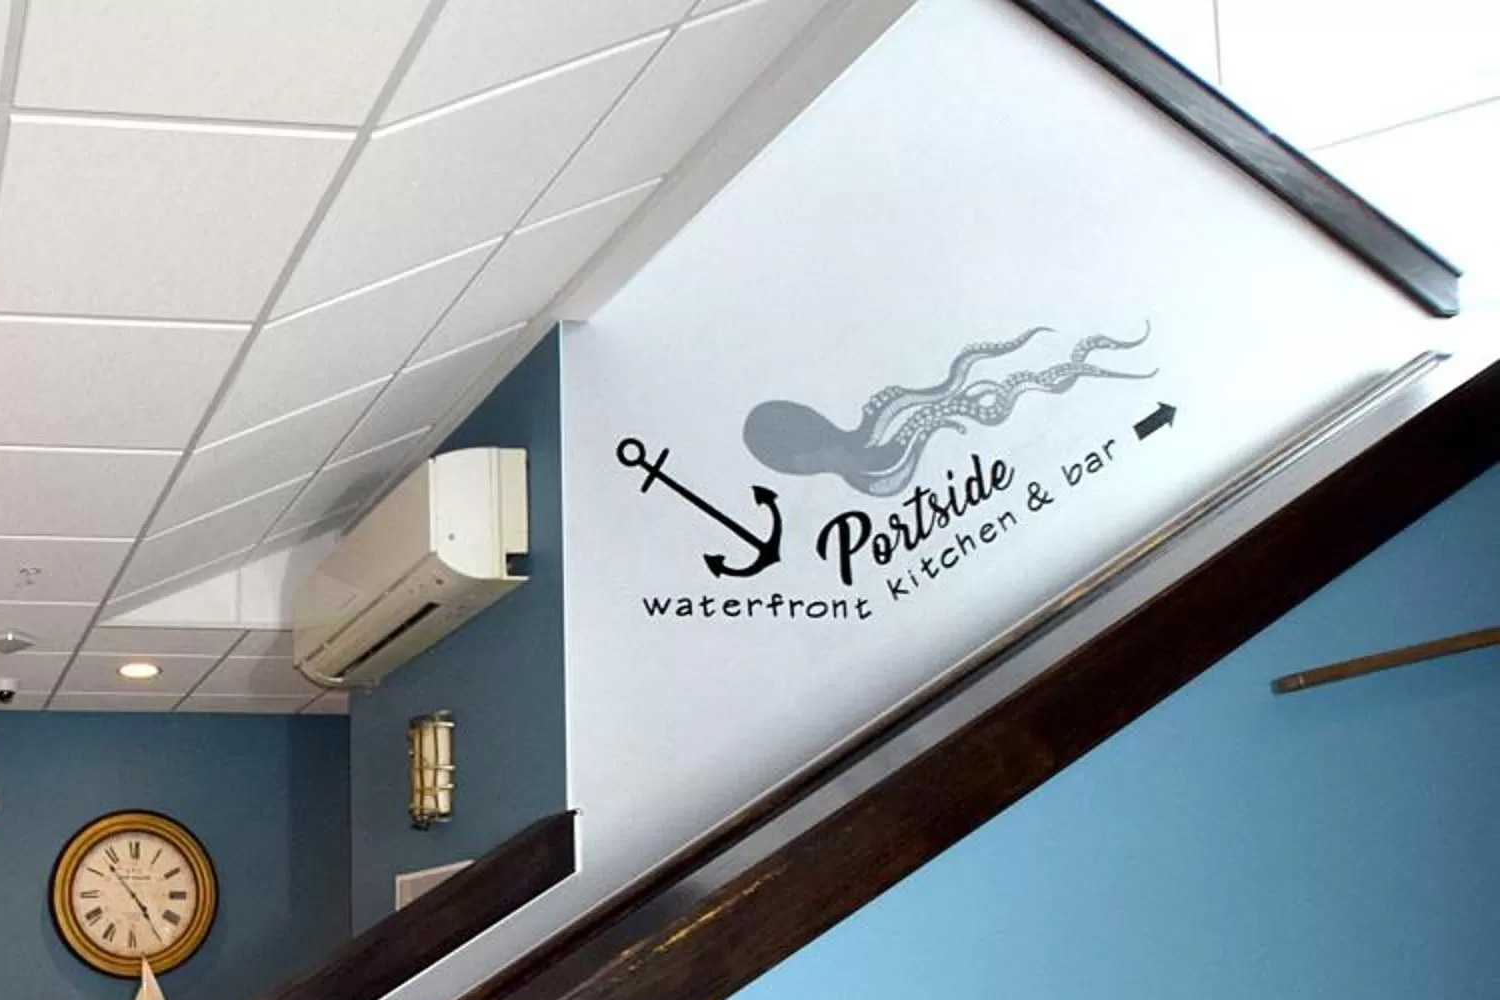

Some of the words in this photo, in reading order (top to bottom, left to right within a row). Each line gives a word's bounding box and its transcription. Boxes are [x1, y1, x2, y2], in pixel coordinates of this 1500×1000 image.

[643, 594, 873, 620] waterfront
[886, 511, 1018, 601] kitchen
[1027, 481, 1055, 512] &
[1061, 439, 1116, 486] bar
[816, 453, 1015, 587] Portside
